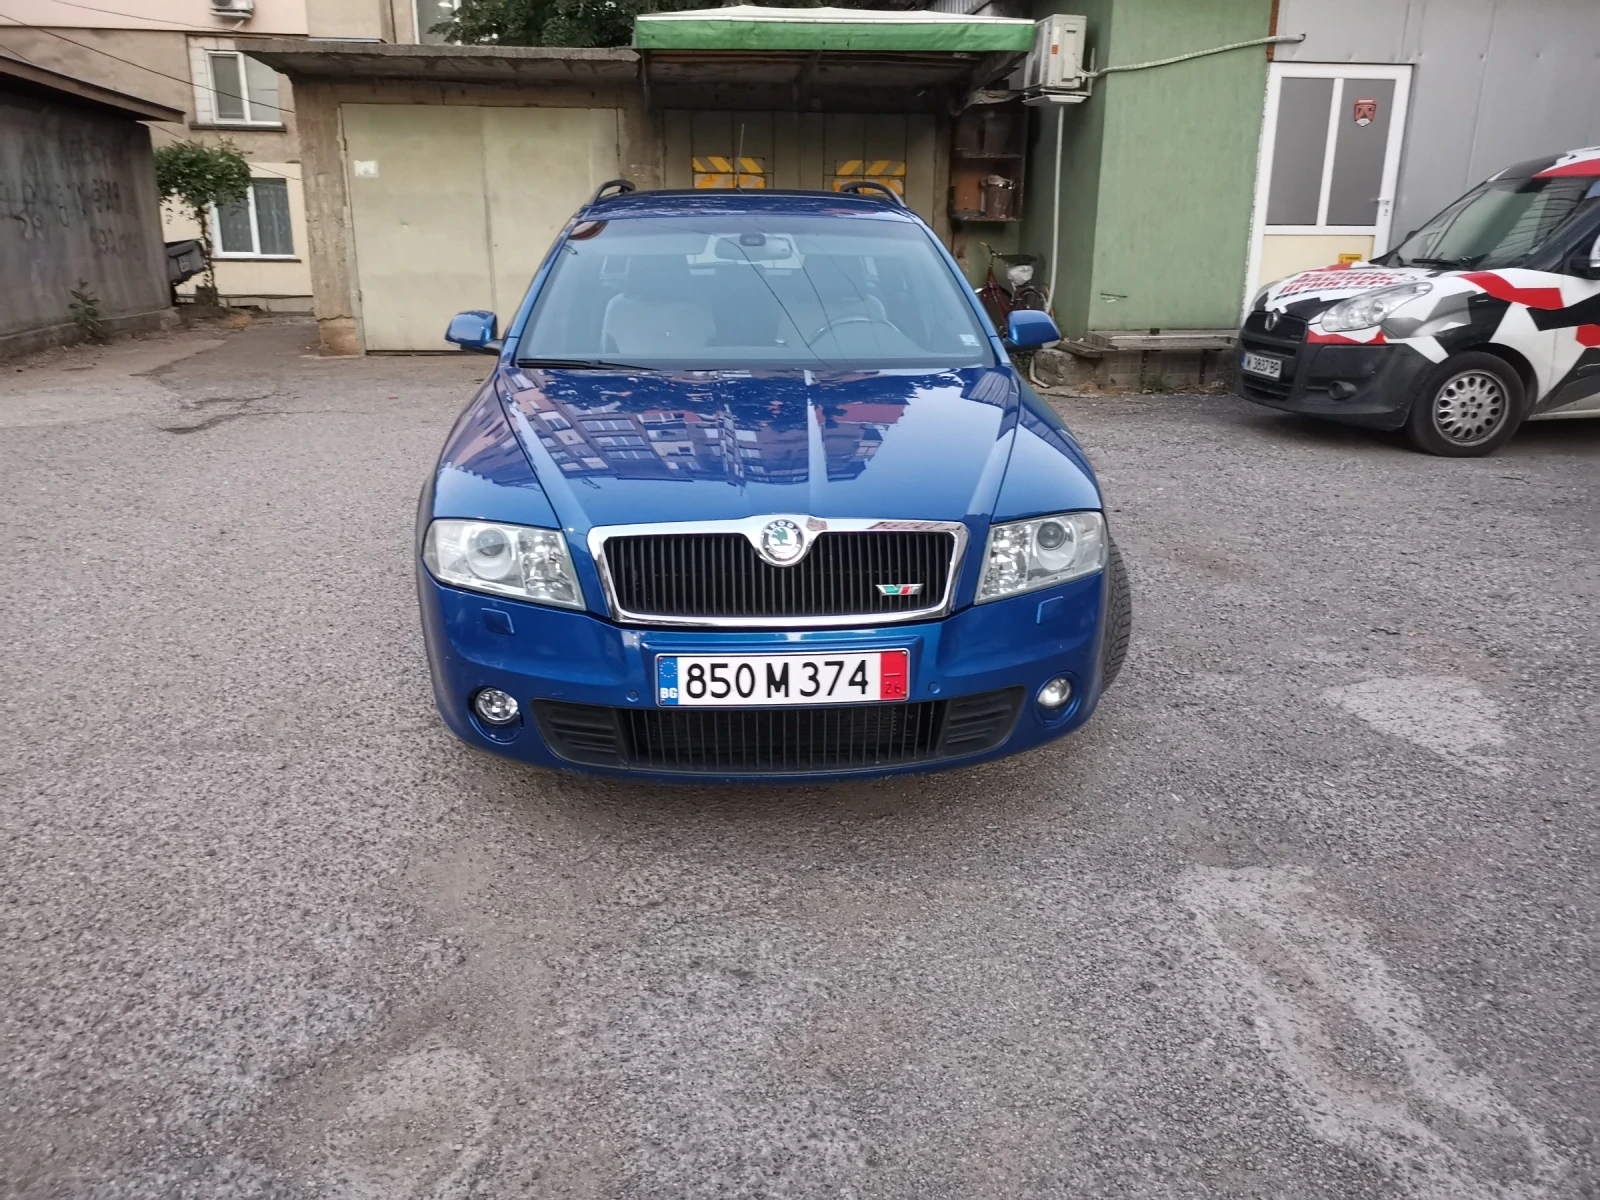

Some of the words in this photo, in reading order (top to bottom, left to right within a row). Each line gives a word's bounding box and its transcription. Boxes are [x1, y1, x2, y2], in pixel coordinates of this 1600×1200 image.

[686, 663, 755, 698] 850
[766, 662, 789, 698] M
[800, 660, 868, 697] 374
[660, 687, 678, 698] BG
[885, 681, 901, 694] 26
